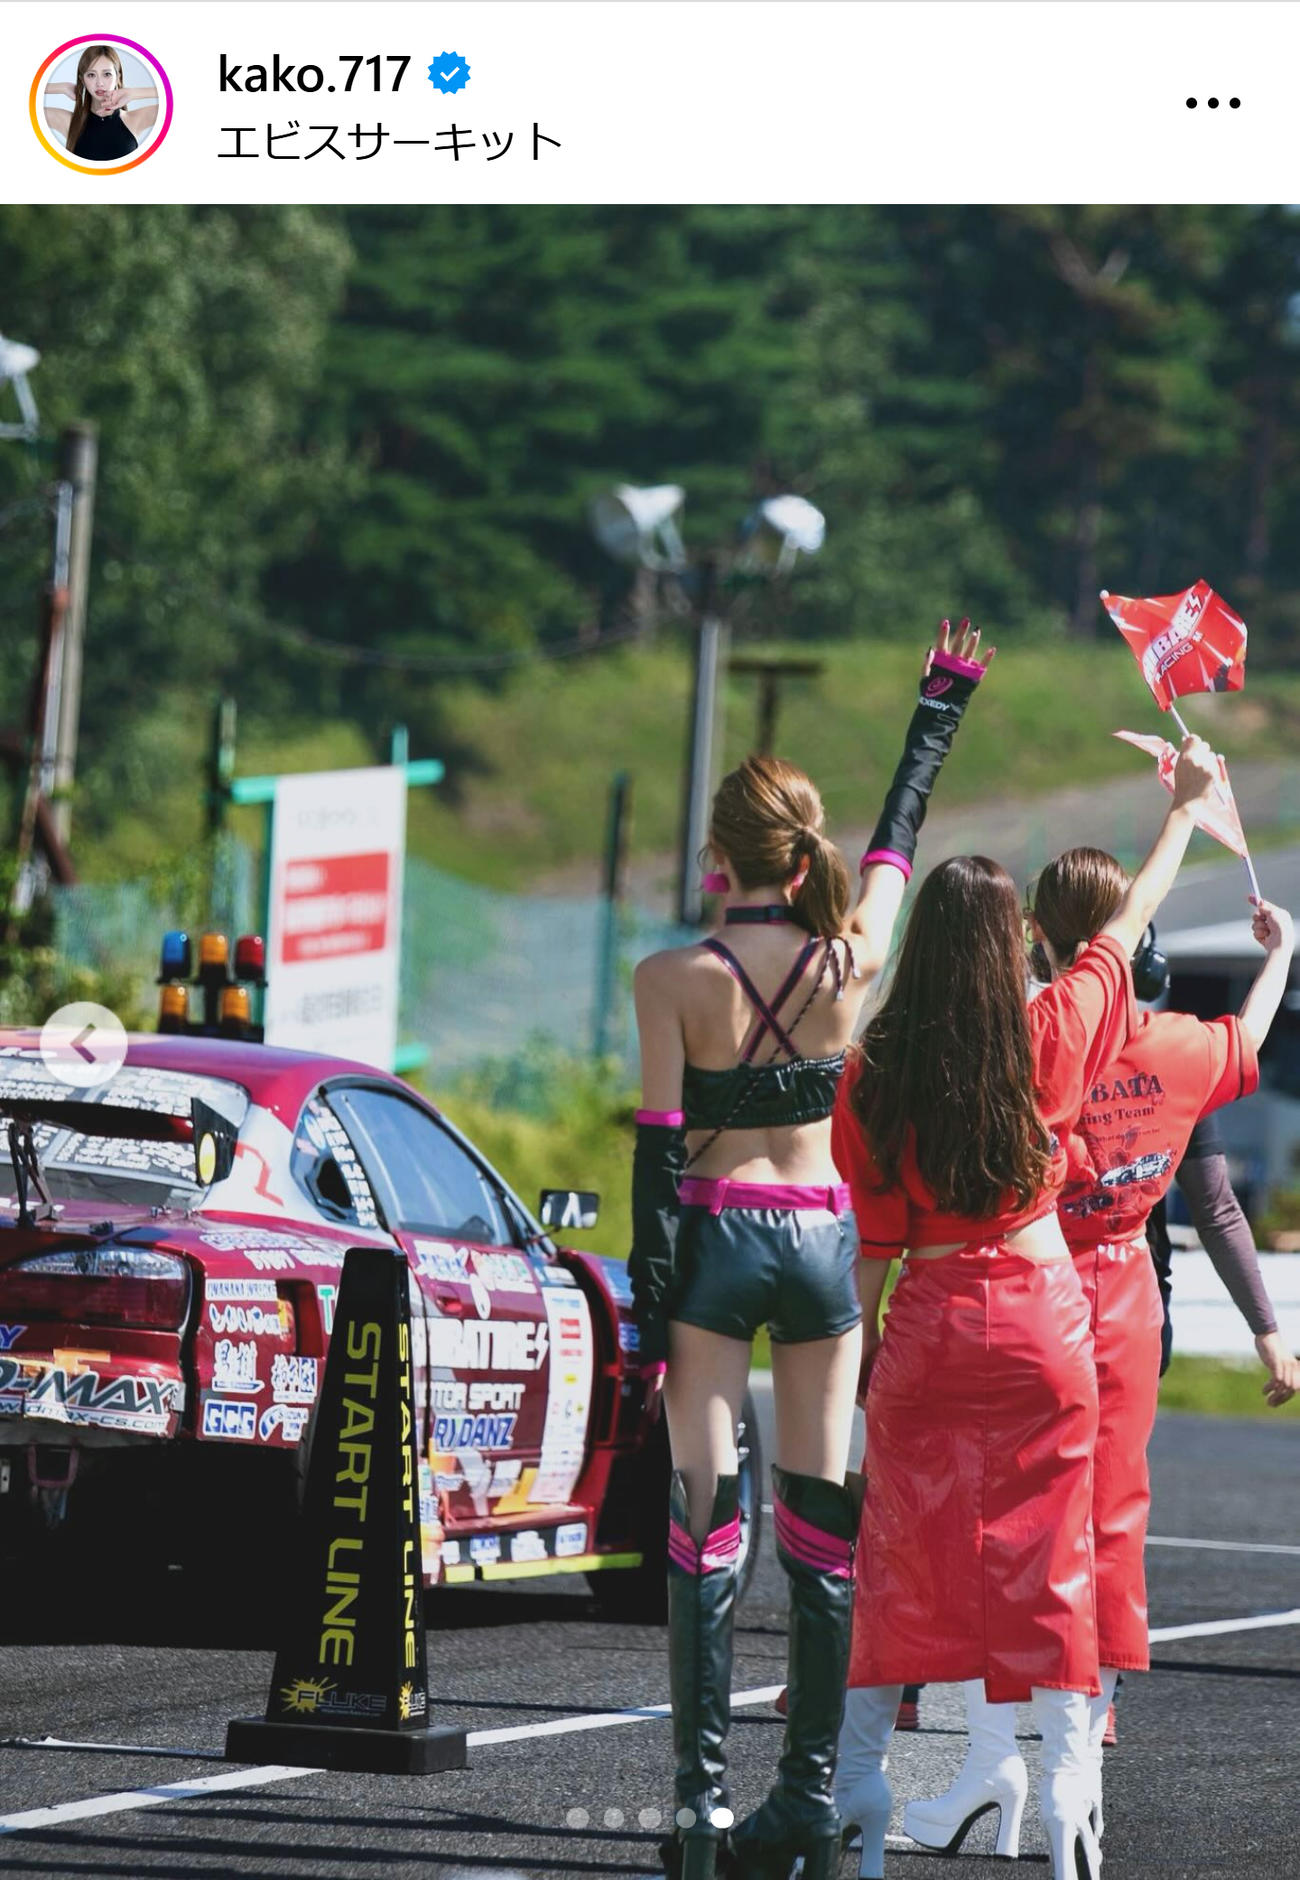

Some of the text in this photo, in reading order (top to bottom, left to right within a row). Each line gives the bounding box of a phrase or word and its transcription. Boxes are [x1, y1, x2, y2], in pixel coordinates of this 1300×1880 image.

[1088, 1074, 1163, 1103] BATA
[1115, 1106, 1155, 1120] Team
[333, 1320, 383, 1522] START
[398, 1322, 415, 1523] START
[468, 1382, 526, 1410] SPORT
[318, 1538, 363, 1666] LINE
[403, 1540, 415, 1668] LINE
